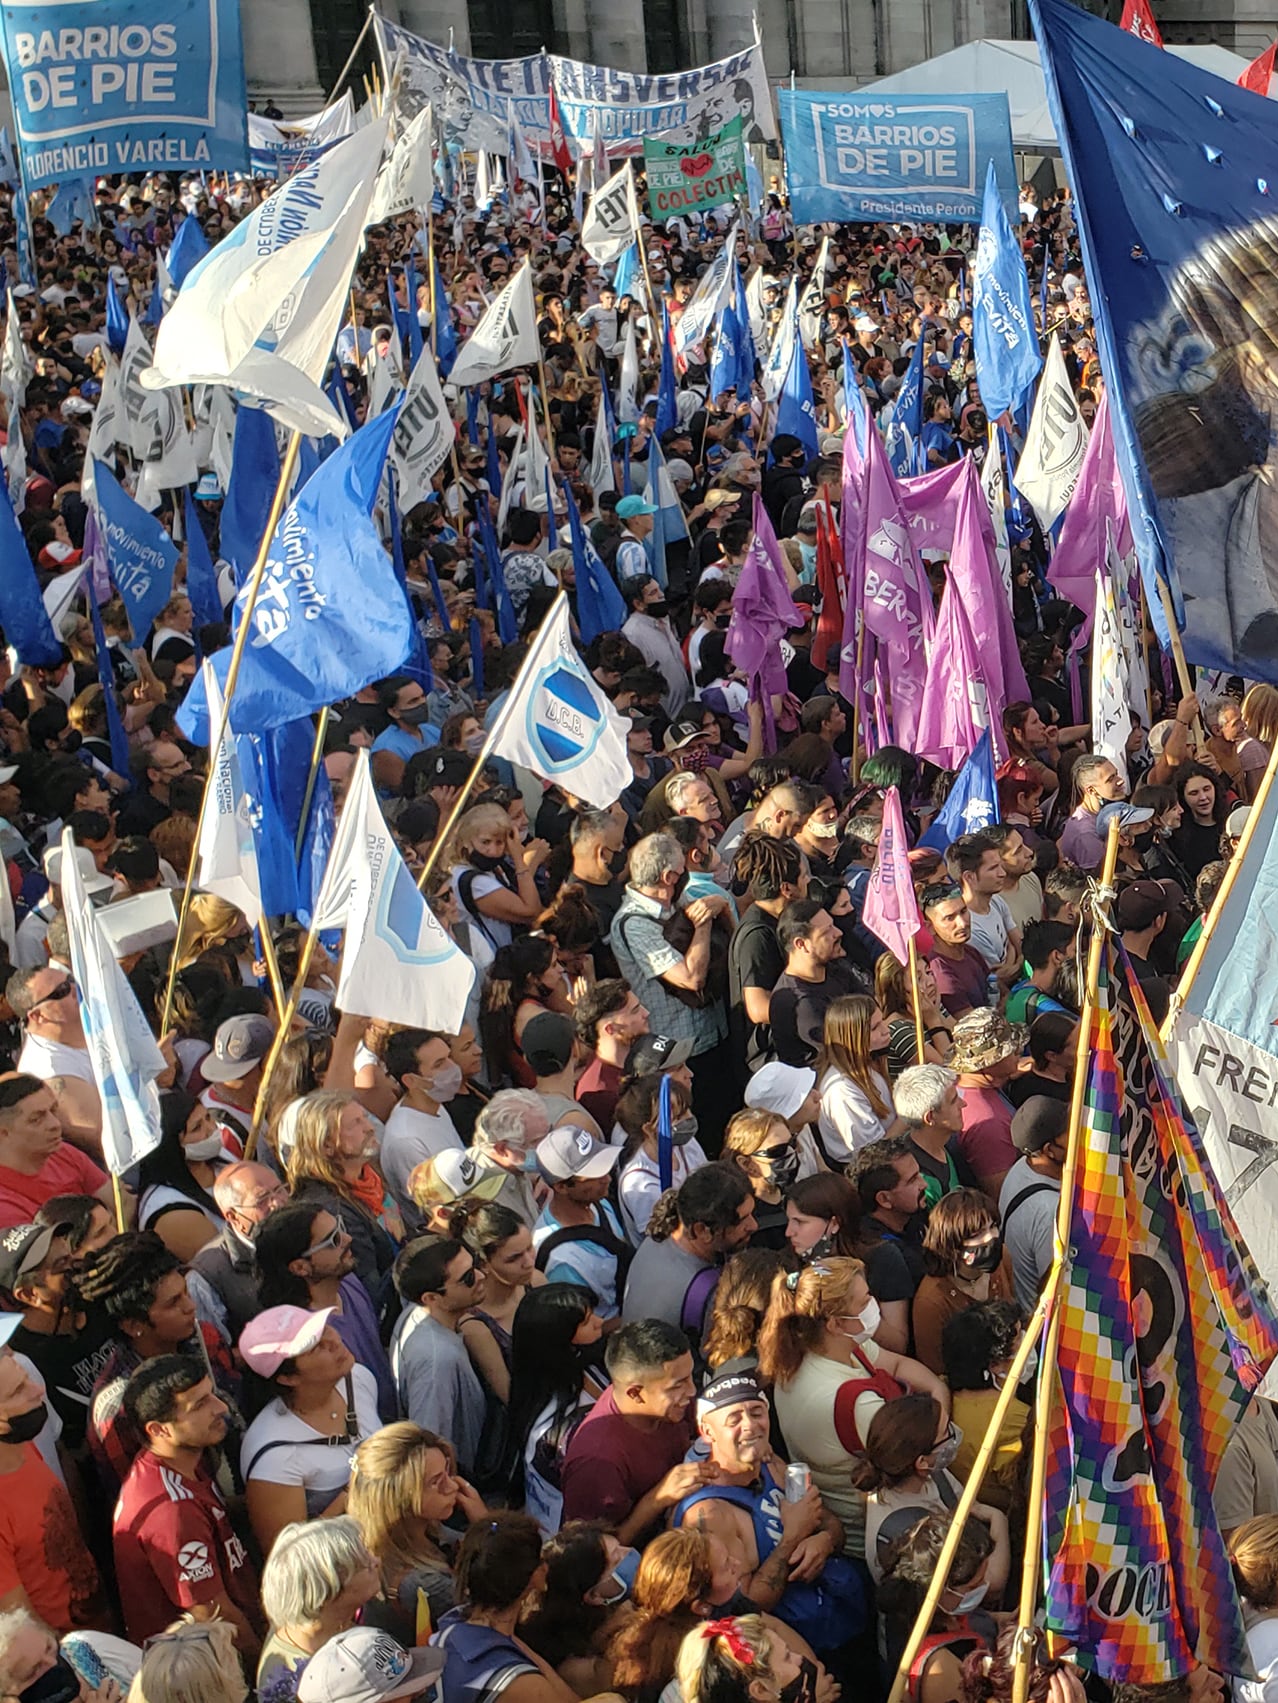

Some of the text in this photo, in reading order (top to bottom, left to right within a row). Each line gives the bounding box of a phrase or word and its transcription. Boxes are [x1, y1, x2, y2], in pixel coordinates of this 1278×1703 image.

[16, 23, 177, 68] BARRIOS
[22, 62, 178, 113] DE PIE
[835, 125, 956, 146] BARRIOS
[116, 139, 211, 164] VARELA
[837, 148, 958, 177] DE PIE
[861, 199, 976, 217] Presidente Perón
[179, 1562, 213, 1582] AXION
